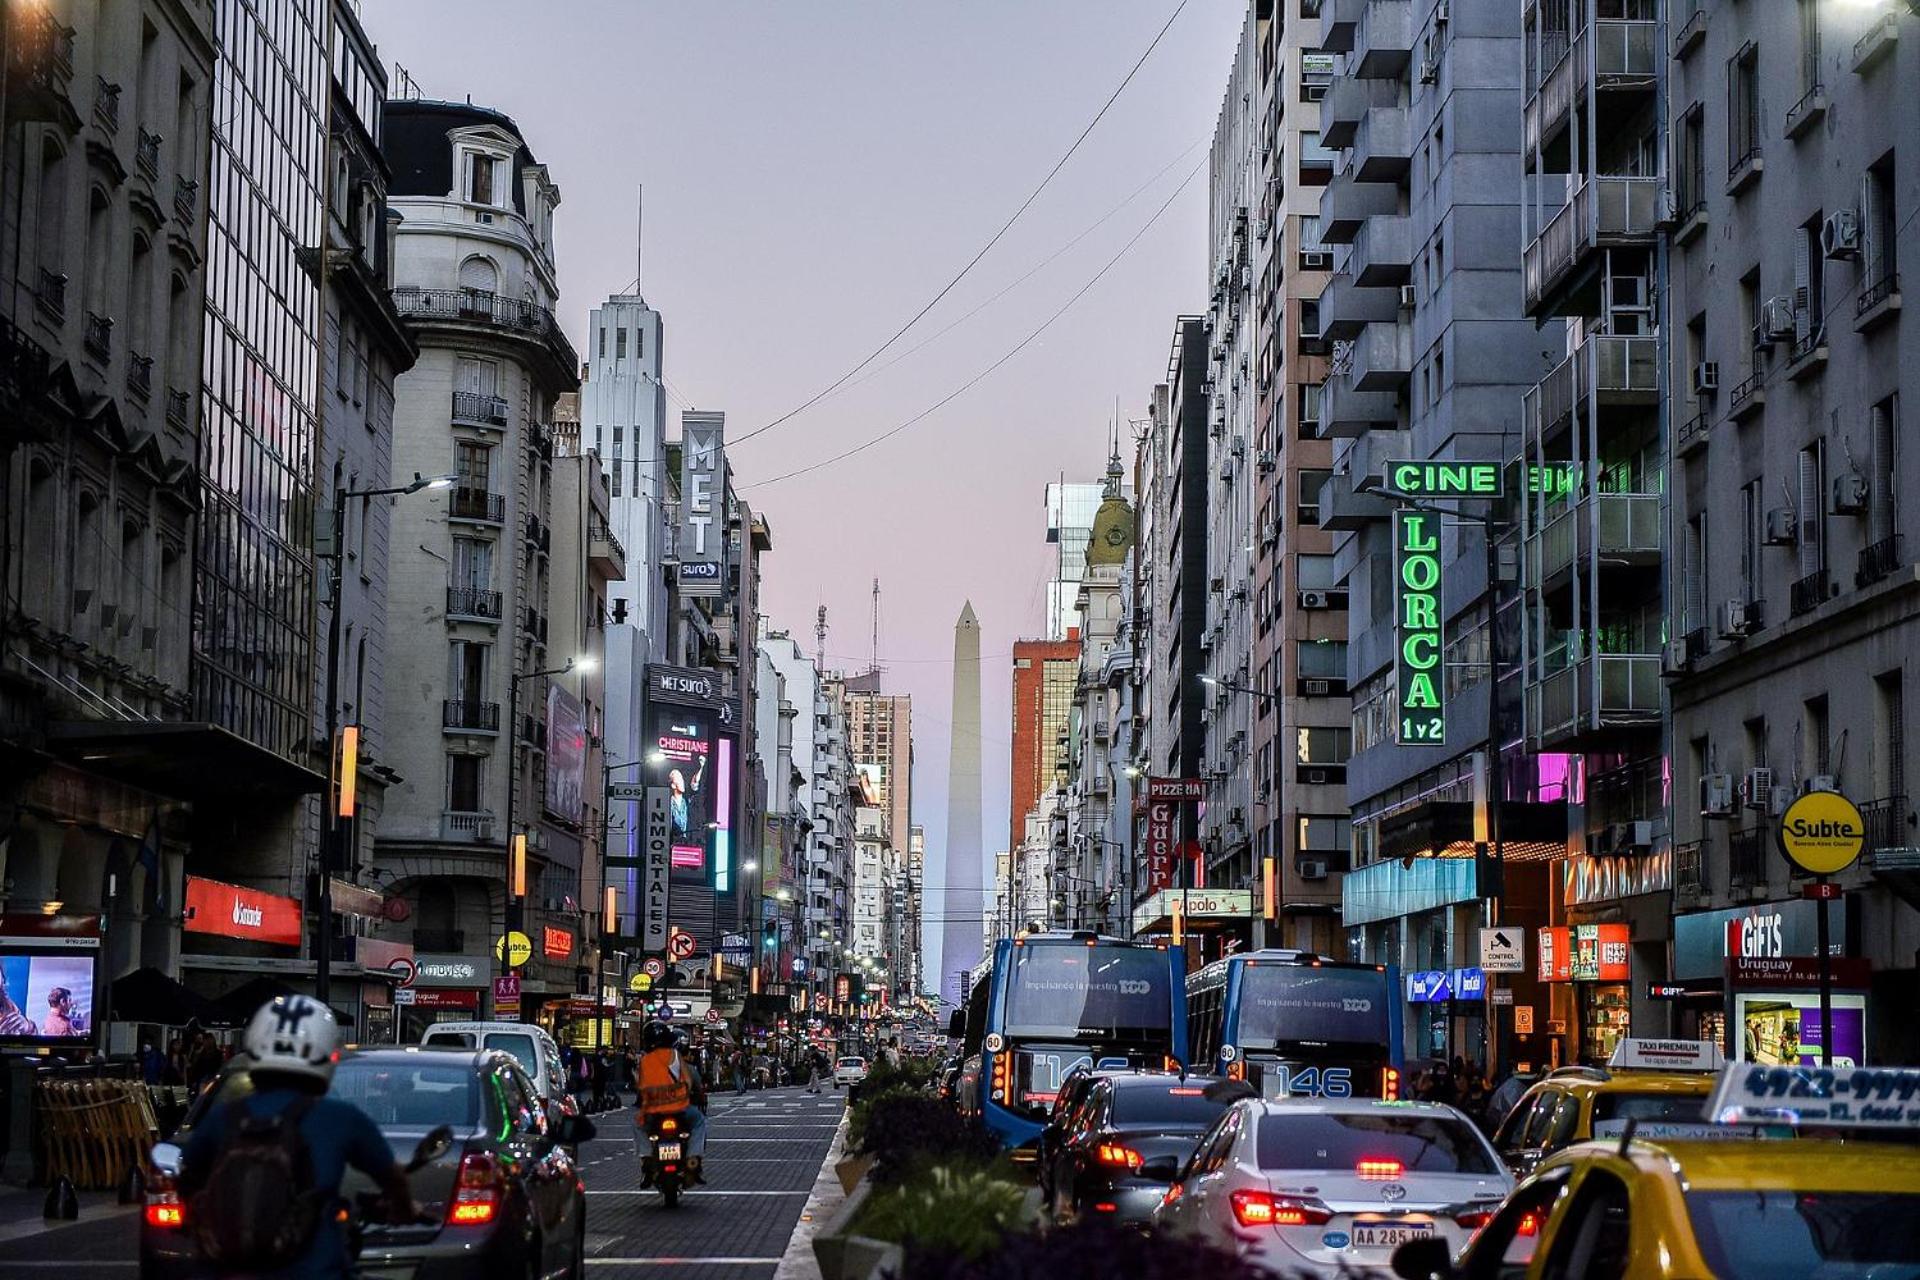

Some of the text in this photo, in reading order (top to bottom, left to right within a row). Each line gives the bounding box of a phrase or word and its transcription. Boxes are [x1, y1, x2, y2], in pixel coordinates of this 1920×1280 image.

[1395, 466, 1495, 491] CINE
[688, 429, 716, 554] MET
[682, 564, 707, 576] sura
[1402, 517, 1440, 708] LORCA
[661, 676, 703, 694] MET sura
[658, 736, 708, 753] CHRISTIANE
[615, 788, 641, 796] LOS
[1793, 819, 1854, 837] Subte
[648, 799, 666, 935] INMORTALES
[1822, 885, 1830, 897] B
[502, 941, 528, 951] ubte
[1724, 921, 1728, 957] I
[1738, 958, 1793, 972] Uruguay
[987, 1036, 999, 1048] 60
[1638, 1042, 1699, 1051] TAXI PREMIUM
[1277, 1066, 1352, 1098] 146
[1356, 1229, 1374, 1244] AA
[1380, 1230, 1406, 1245] 285
